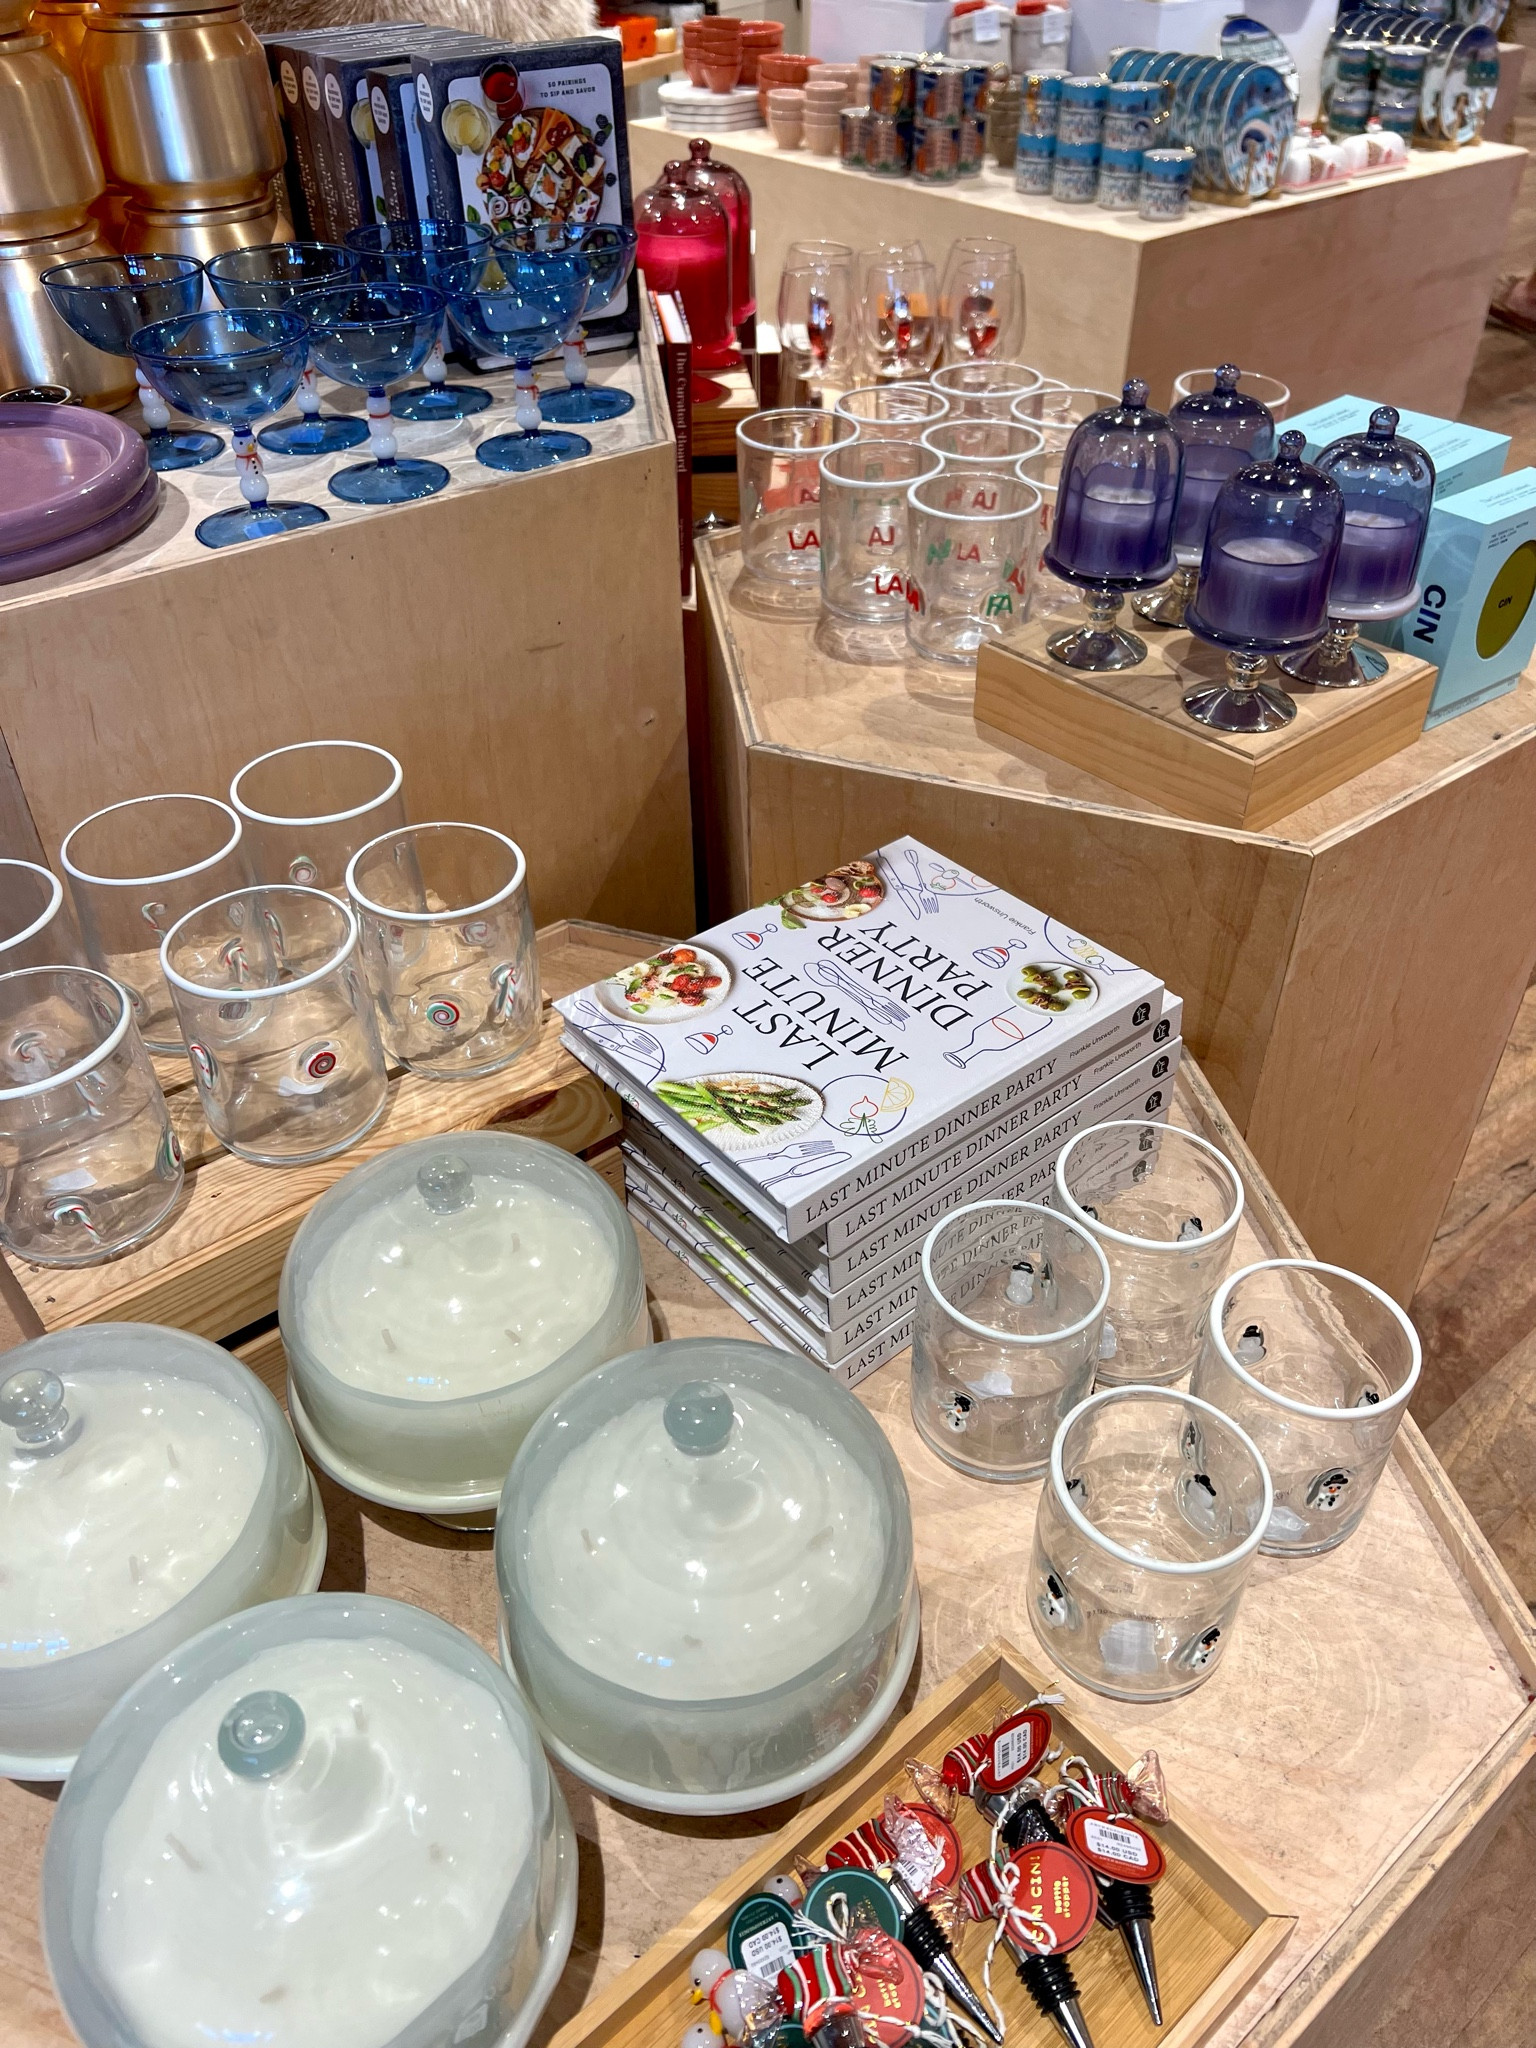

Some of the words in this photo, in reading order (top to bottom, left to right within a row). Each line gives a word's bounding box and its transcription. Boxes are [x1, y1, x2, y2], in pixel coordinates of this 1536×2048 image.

[677, 378, 687, 429] Curated
[1009, 917, 1036, 935] Frankie
[817, 925, 974, 1031] DINNER
[859, 921, 993, 1001] PARTY
[732, 999, 839, 1070] LAST
[742, 957, 909, 1073] MINUTE
[1069, 1042, 1091, 1059] Frankie
[1092, 1025, 1120, 1045] Unsworth
[806, 1185, 850, 1224] LAST
[855, 1136, 930, 1193] MINUTE
[934, 1094, 1002, 1144] DINNER
[1005, 1058, 1057, 1101] PARTY
[845, 1200, 886, 1238] LAST
[892, 1152, 963, 1208] MINUTE
[965, 1108, 1030, 1160] DINNER
[1033, 1074, 1082, 1118] PARTY
[847, 1235, 888, 1273] LAST
[893, 1191, 964, 1243] MINUTE
[967, 1145, 1030, 1195] DINNER
[1034, 1110, 1082, 1153] PARTY
[847, 1271, 887, 1310] LAST
[844, 1306, 884, 1345] LAST
[847, 1341, 886, 1380] LAST
[1053, 1880, 1063, 1914] bottle
[1062, 1875, 1071, 1919] stopper
